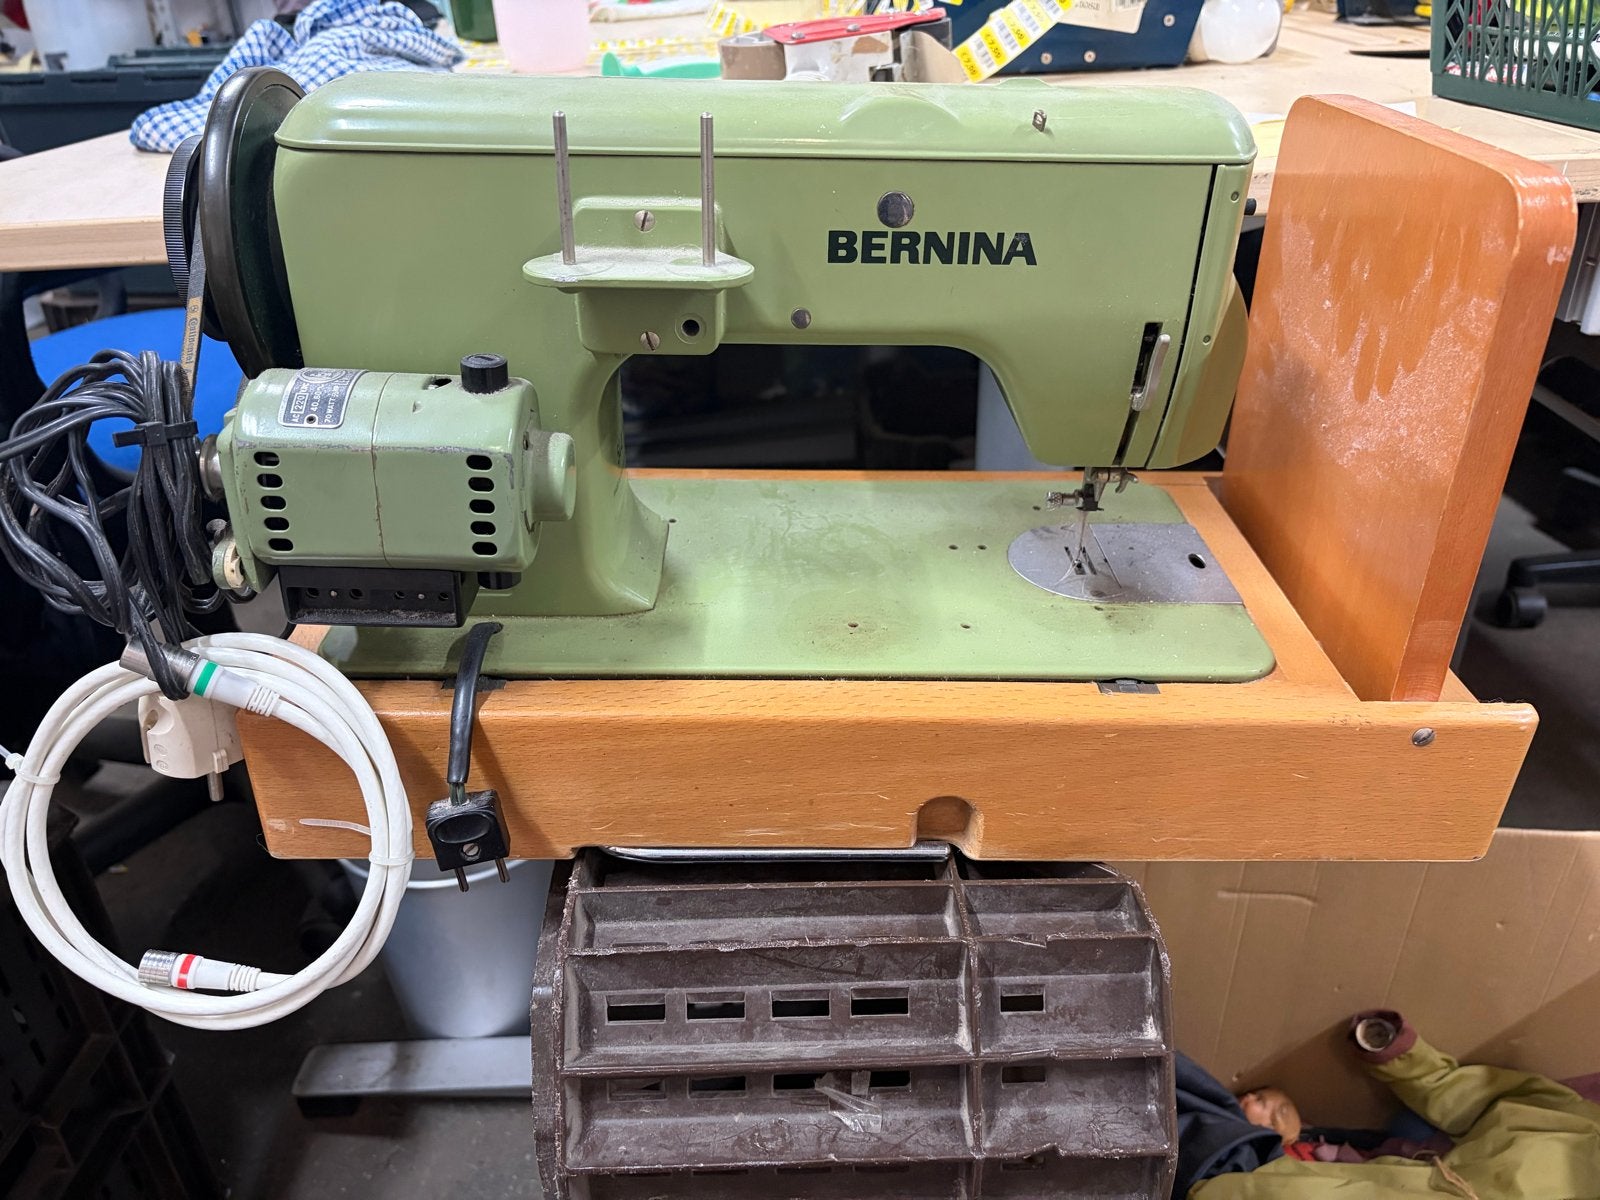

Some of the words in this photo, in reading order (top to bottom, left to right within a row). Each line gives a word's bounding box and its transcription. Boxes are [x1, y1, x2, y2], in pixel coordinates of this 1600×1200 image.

[828, 230, 1037, 265] BERNINA
[295, 396, 305, 410] 220
[326, 398, 335, 413] WATT
[324, 414, 332, 423] 70
